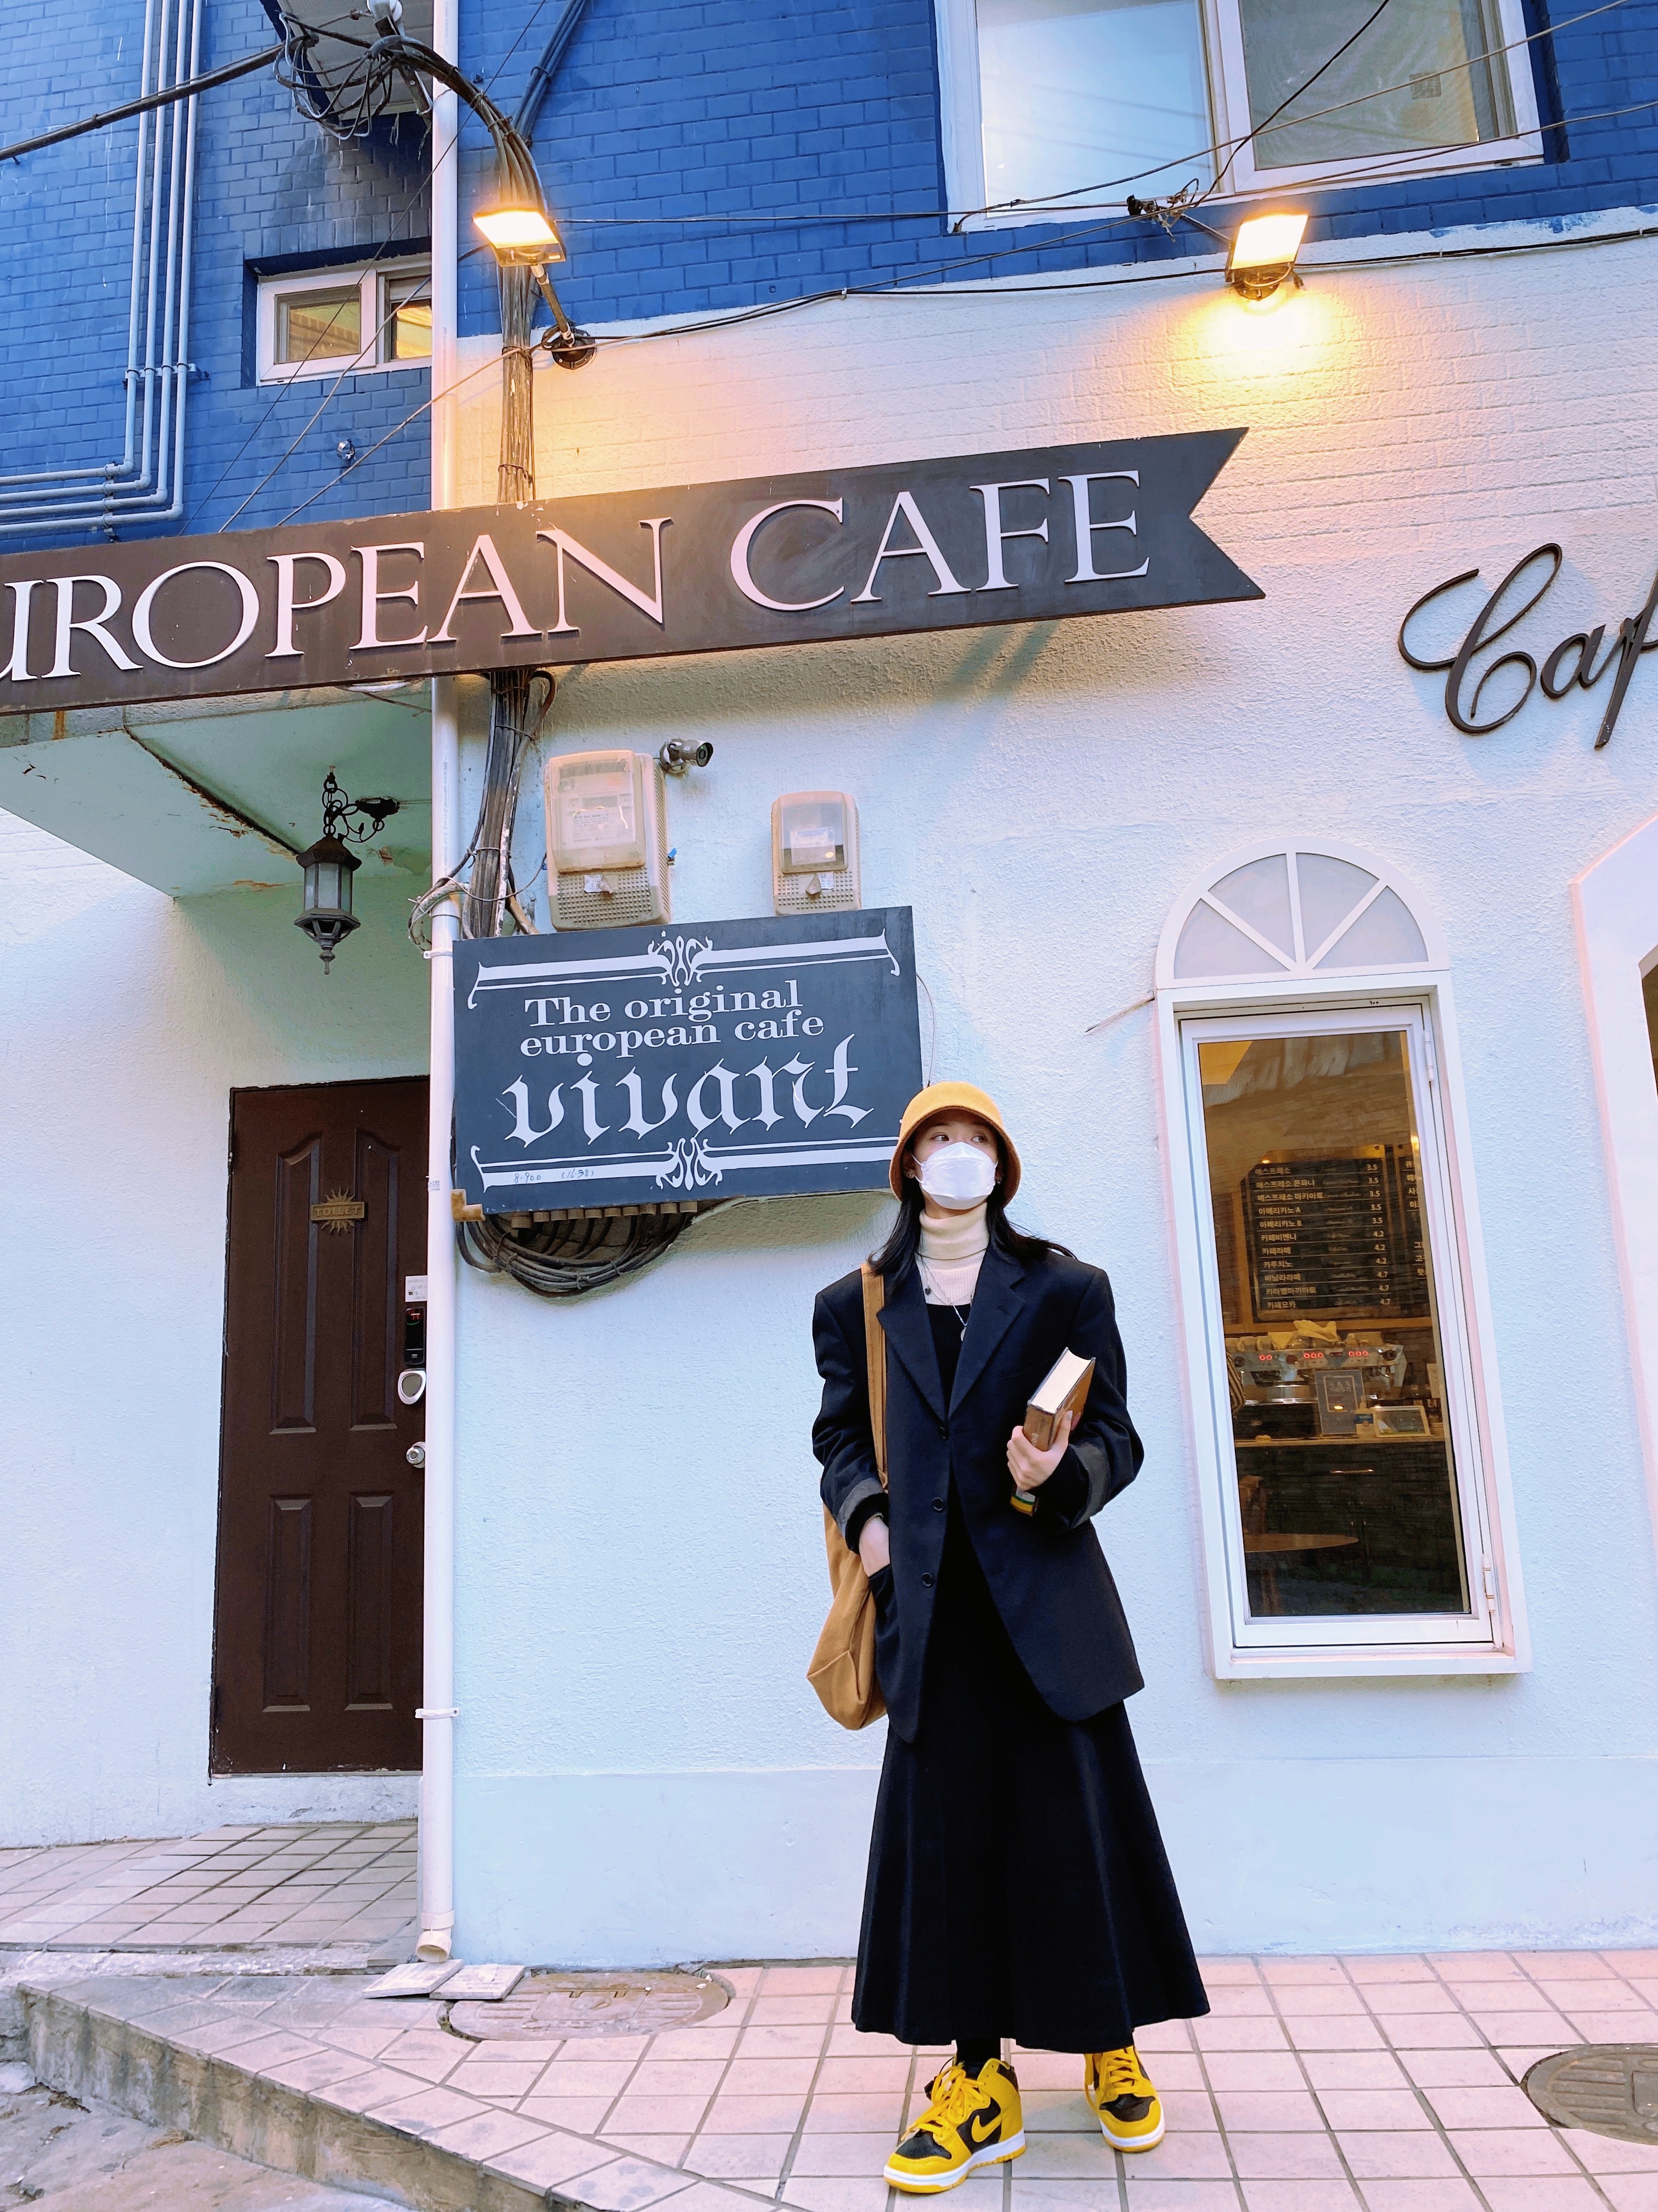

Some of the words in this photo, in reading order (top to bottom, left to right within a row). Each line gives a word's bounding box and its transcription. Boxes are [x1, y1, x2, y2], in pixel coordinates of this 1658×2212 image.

[729, 470, 1150, 612] CAFE
[524, 996, 612, 1028] The
[624, 980, 804, 1023] original
[520, 1023, 722, 1059] european
[734, 1009, 825, 1041] cafe
[501, 1033, 875, 1149] vivant
[1255, 1167, 1291, 1175] 에스프레소
[1256, 1180, 1293, 1188] 에스프레소
[1257, 1193, 1293, 1201] 에스프레소
[314, 1206, 360, 1217] TOILET
[1260, 1220, 1296, 1228] 아메리카노
